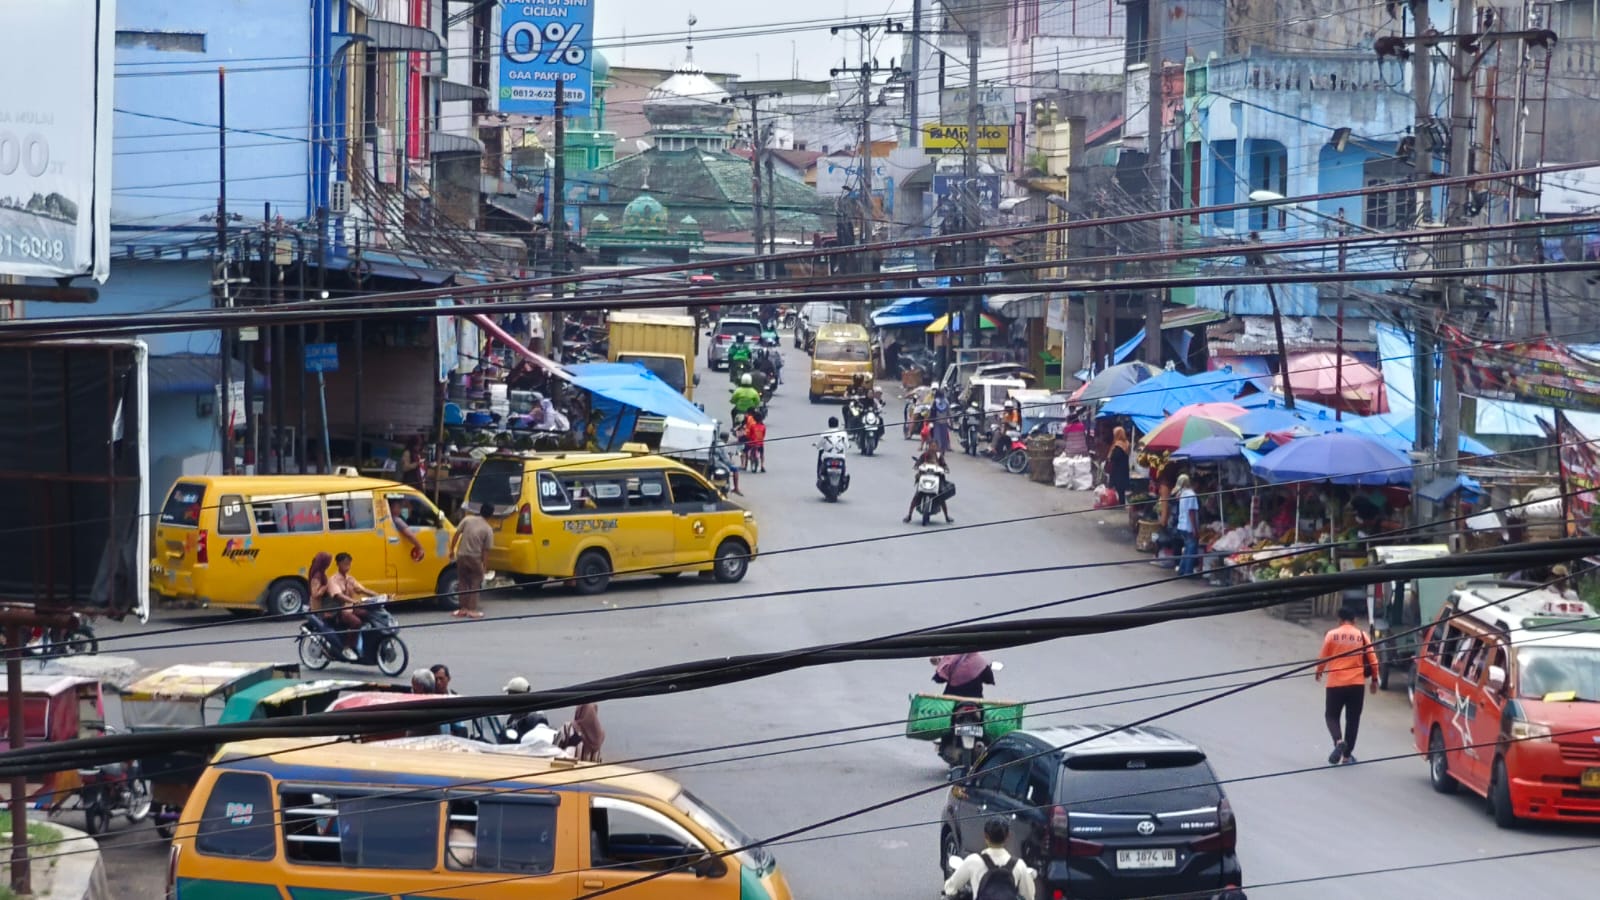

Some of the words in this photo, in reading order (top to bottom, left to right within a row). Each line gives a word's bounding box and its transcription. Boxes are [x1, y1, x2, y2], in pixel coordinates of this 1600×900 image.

[523, 6, 568, 17] CICILAN
[503, 20, 586, 64] 0%
[562, 73, 577, 81] DP
[953, 90, 1003, 102] APTEK
[541, 481, 557, 496] 08
